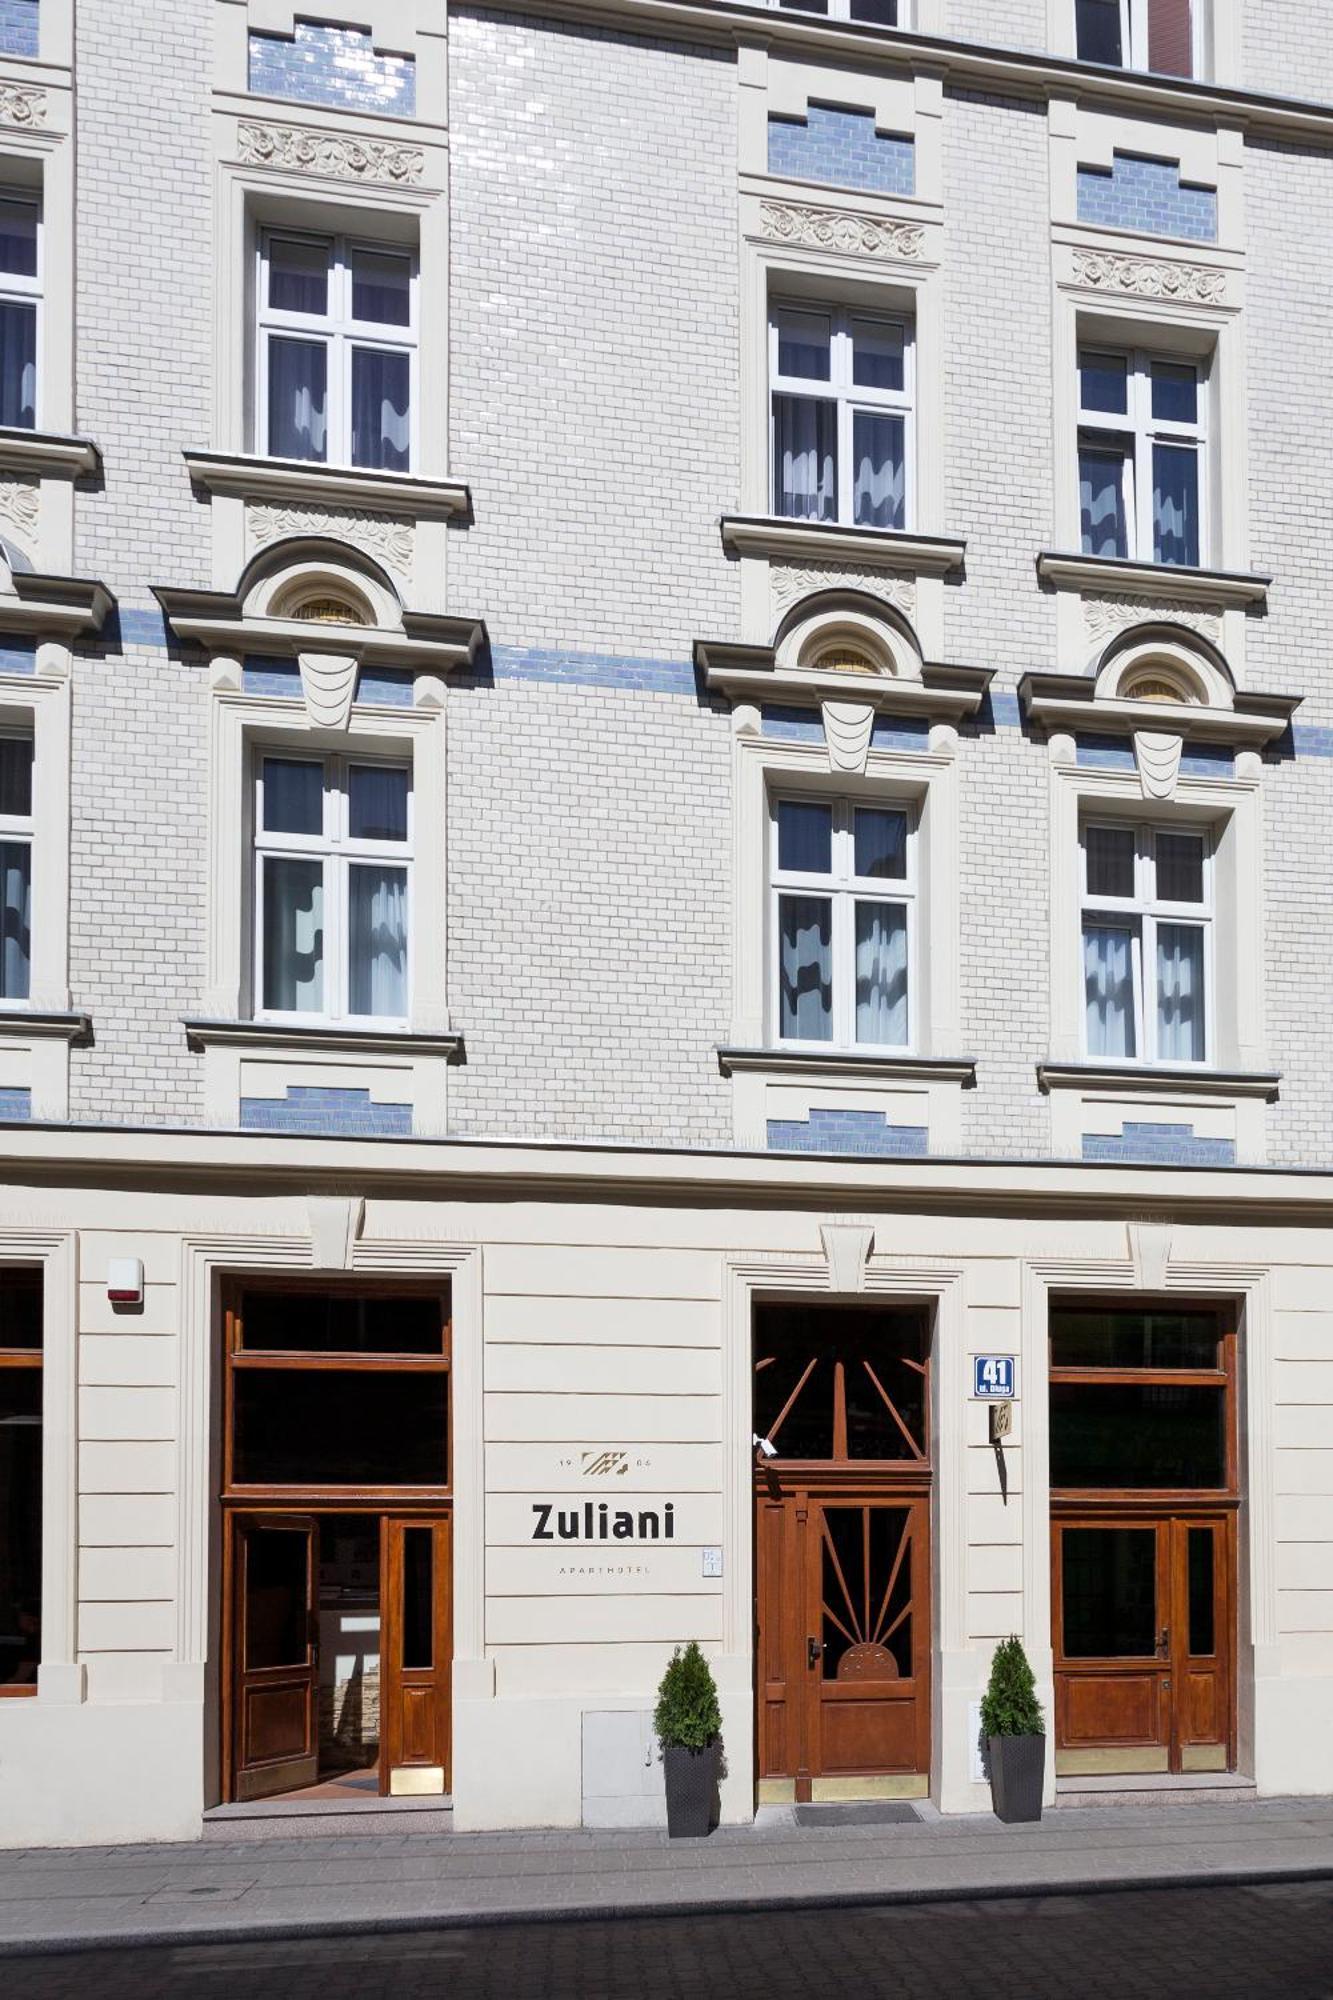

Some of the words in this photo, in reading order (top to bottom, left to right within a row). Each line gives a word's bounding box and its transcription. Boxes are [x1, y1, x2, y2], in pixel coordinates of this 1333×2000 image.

[983, 1360, 1006, 1385] 41
[559, 1459, 571, 1467] 19
[531, 1502, 674, 1539] Zuliani
[559, 1566, 650, 1575] APARTHOTEL
